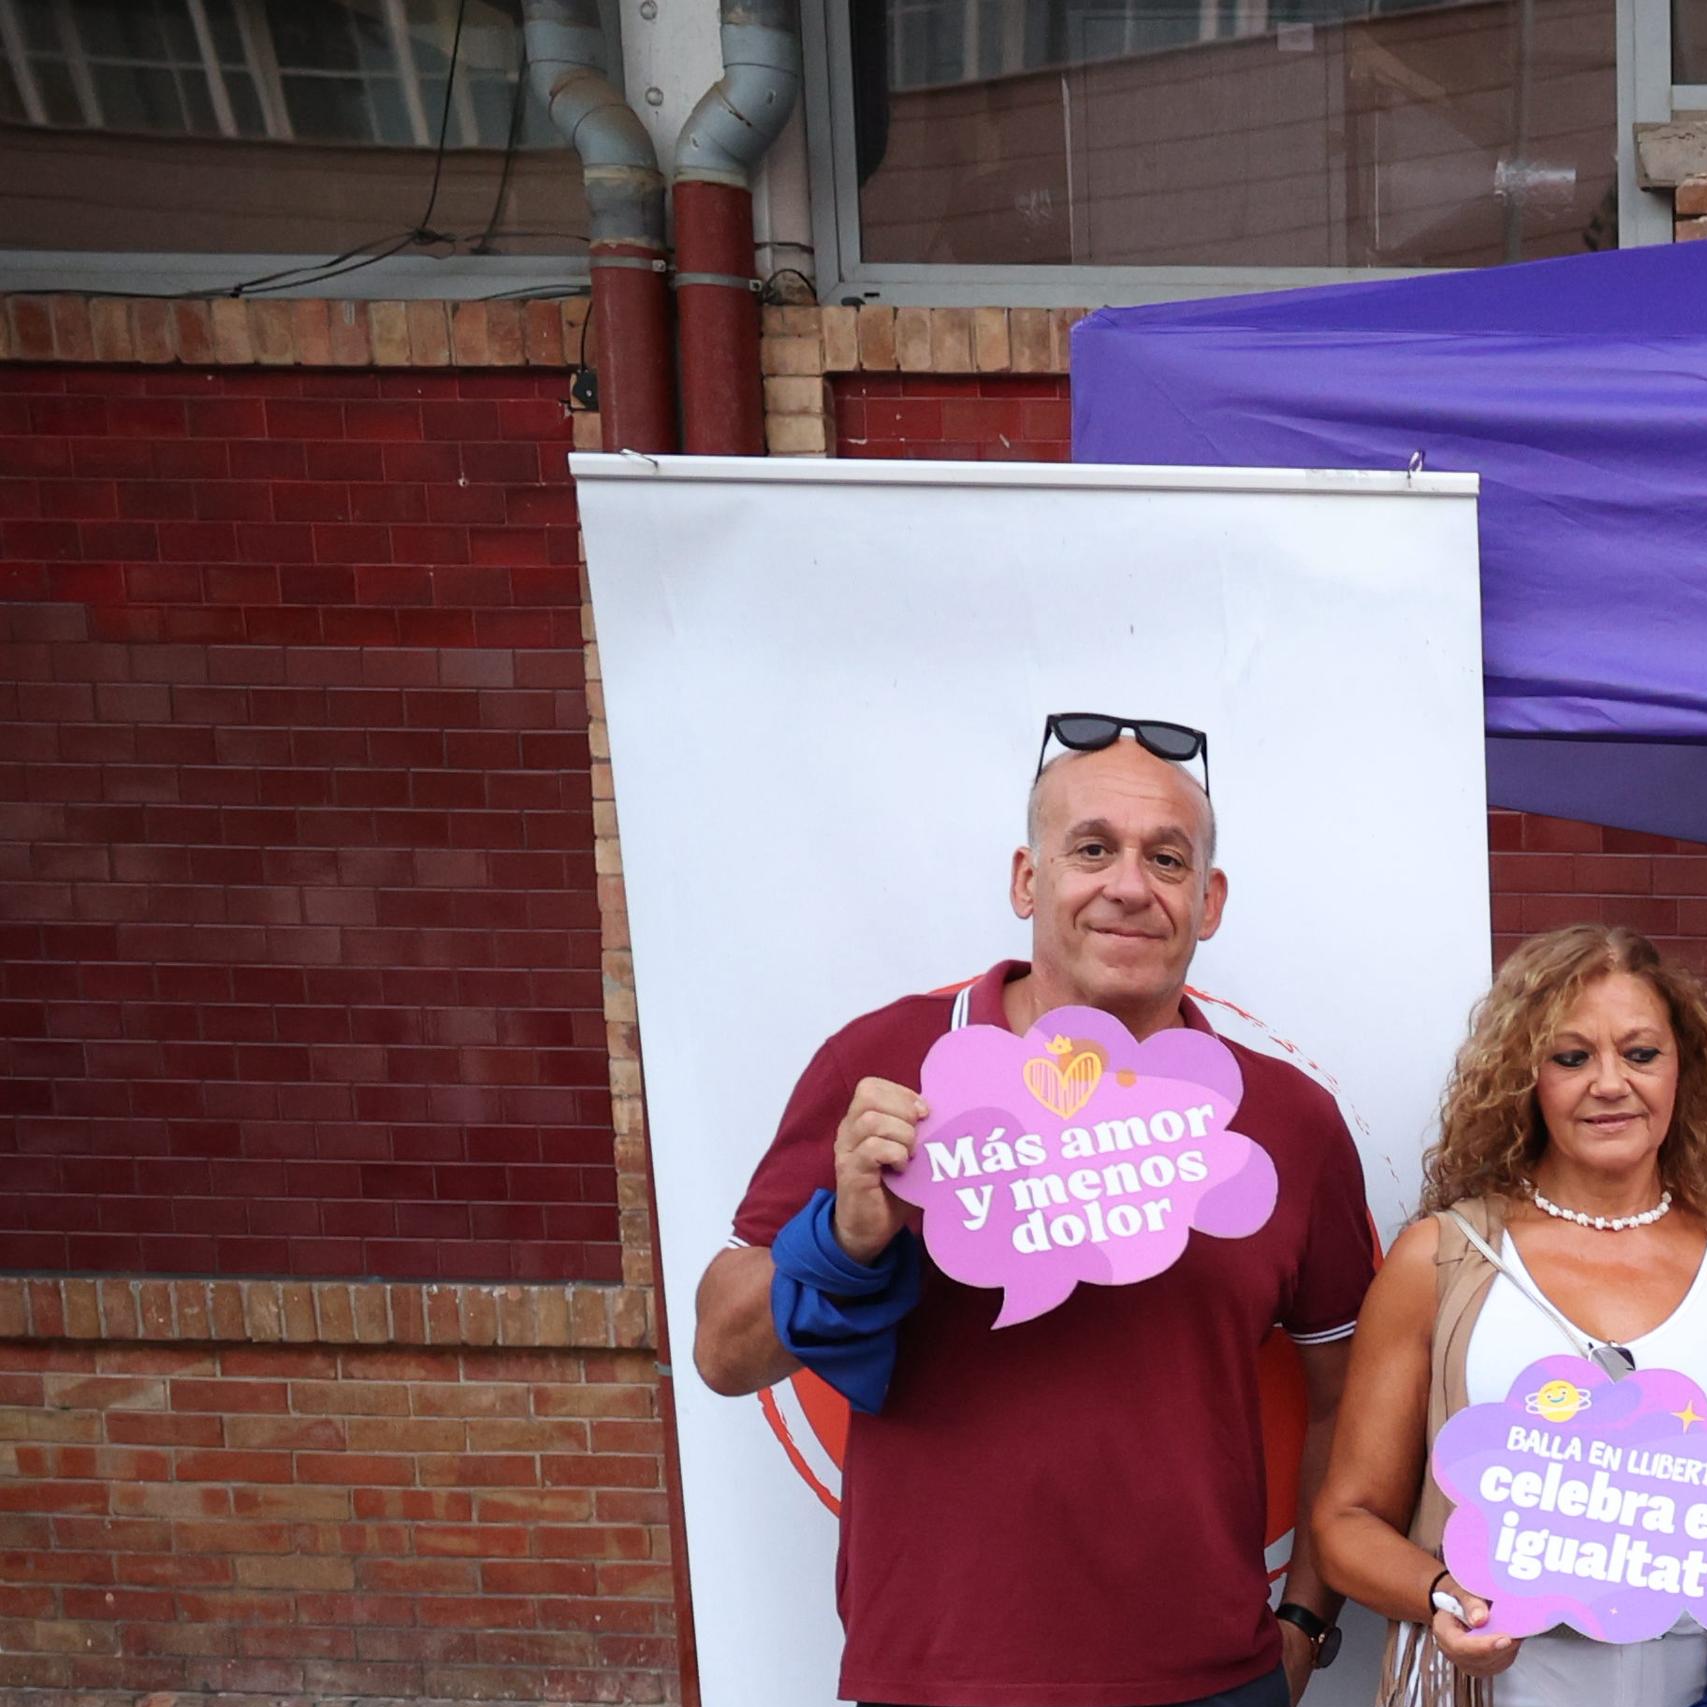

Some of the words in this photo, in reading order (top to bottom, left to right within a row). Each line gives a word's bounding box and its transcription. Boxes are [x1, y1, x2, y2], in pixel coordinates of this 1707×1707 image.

[923, 1128, 1047, 1183] Más
[1060, 1102, 1215, 1160] amor
[955, 1183, 993, 1231] y
[1009, 1150, 1209, 1212] menos
[1011, 1197, 1173, 1255] dolor
[1506, 1426, 1582, 1463] BALLA
[1589, 1445, 1623, 1472] EN
[1480, 1462, 1675, 1535] celebra
